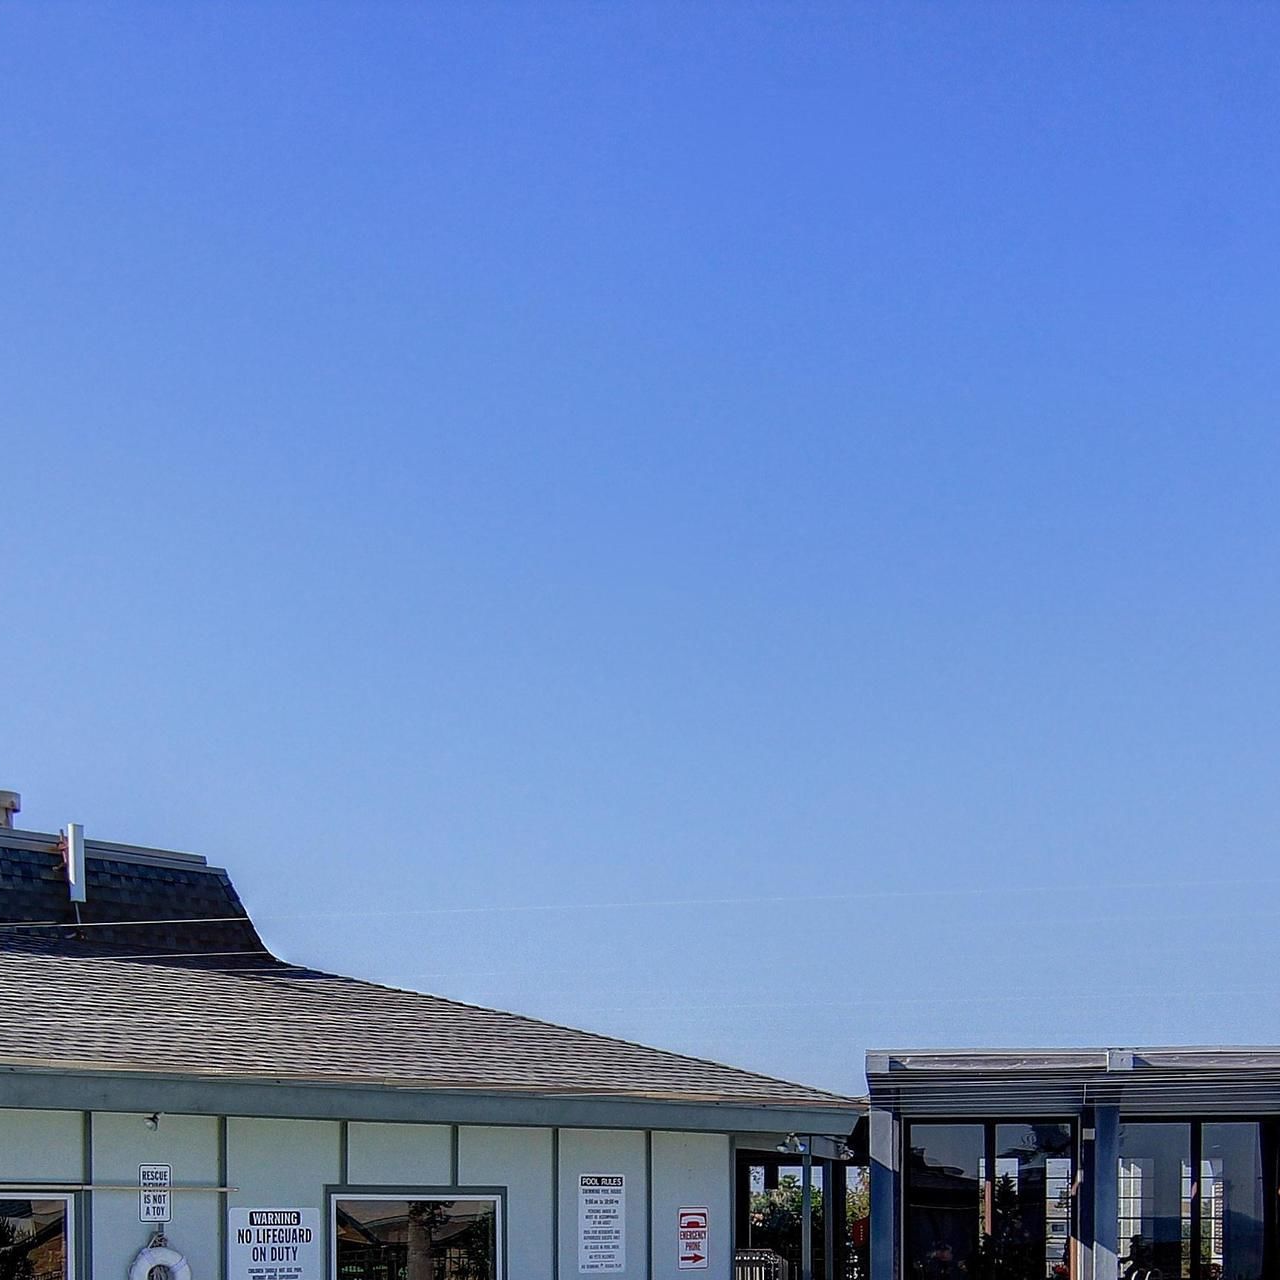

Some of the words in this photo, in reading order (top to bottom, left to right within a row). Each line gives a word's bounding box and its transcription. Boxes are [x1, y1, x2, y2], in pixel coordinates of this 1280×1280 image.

[142, 1171, 168, 1180] RESCUE
[582, 1178, 599, 1186] POOL
[601, 1178, 621, 1186] RULES
[144, 1195, 151, 1204] IS
[153, 1195, 166, 1204] NOT
[145, 1207, 151, 1216] A
[152, 1207, 165, 1216] TOY
[252, 1212, 298, 1225] WARNING
[237, 1229, 252, 1243] NO
[256, 1228, 312, 1243] LIFEGUARD
[680, 1231, 706, 1240] EMERGENCY
[686, 1241, 701, 1251] PHONE
[252, 1247, 266, 1261] ON
[271, 1247, 298, 1261] DUTY
